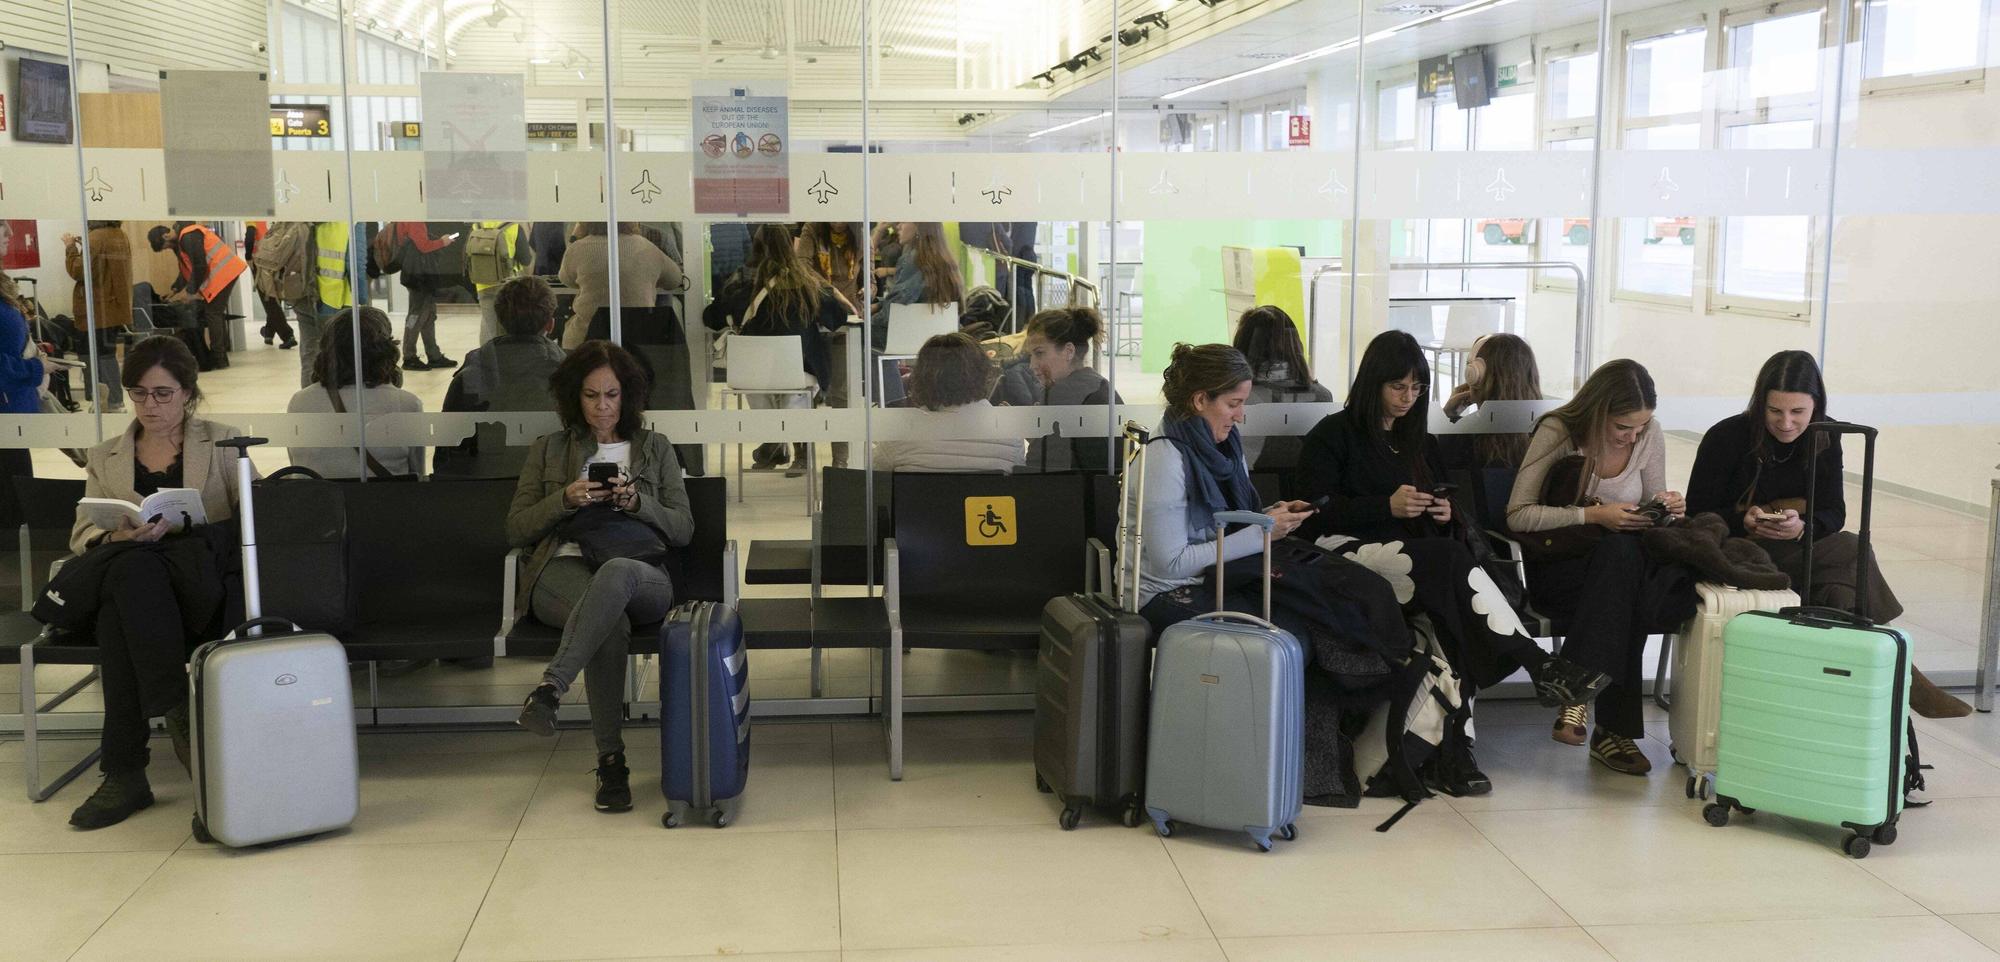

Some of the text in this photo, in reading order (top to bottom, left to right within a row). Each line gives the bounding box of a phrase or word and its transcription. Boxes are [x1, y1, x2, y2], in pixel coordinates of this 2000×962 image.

[287, 119, 329, 136] Puerta 3
[711, 121, 745, 129] EUROPEAN
